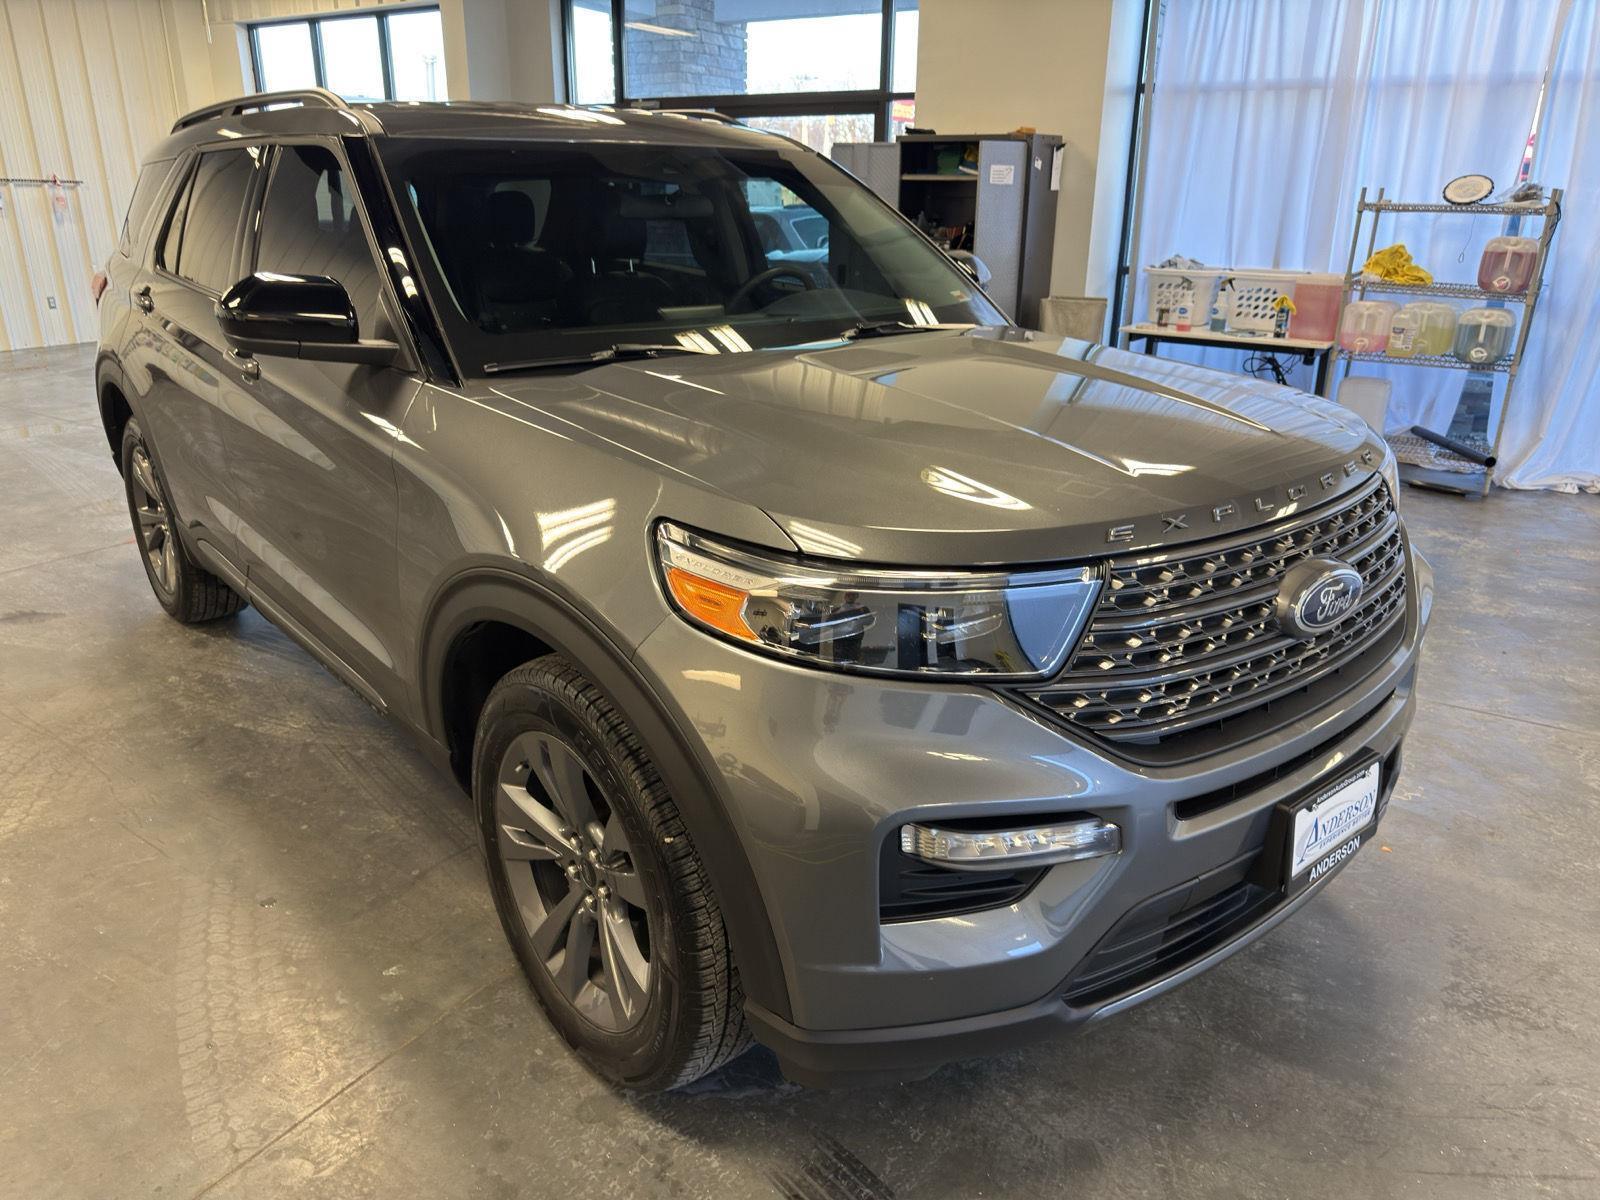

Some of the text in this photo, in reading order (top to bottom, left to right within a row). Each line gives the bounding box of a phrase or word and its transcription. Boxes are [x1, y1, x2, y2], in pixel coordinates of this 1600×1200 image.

[1107, 449, 1373, 543] EXPLORER
[1316, 582, 1354, 621] Ford
[1309, 835, 1361, 882] ANDERSON
